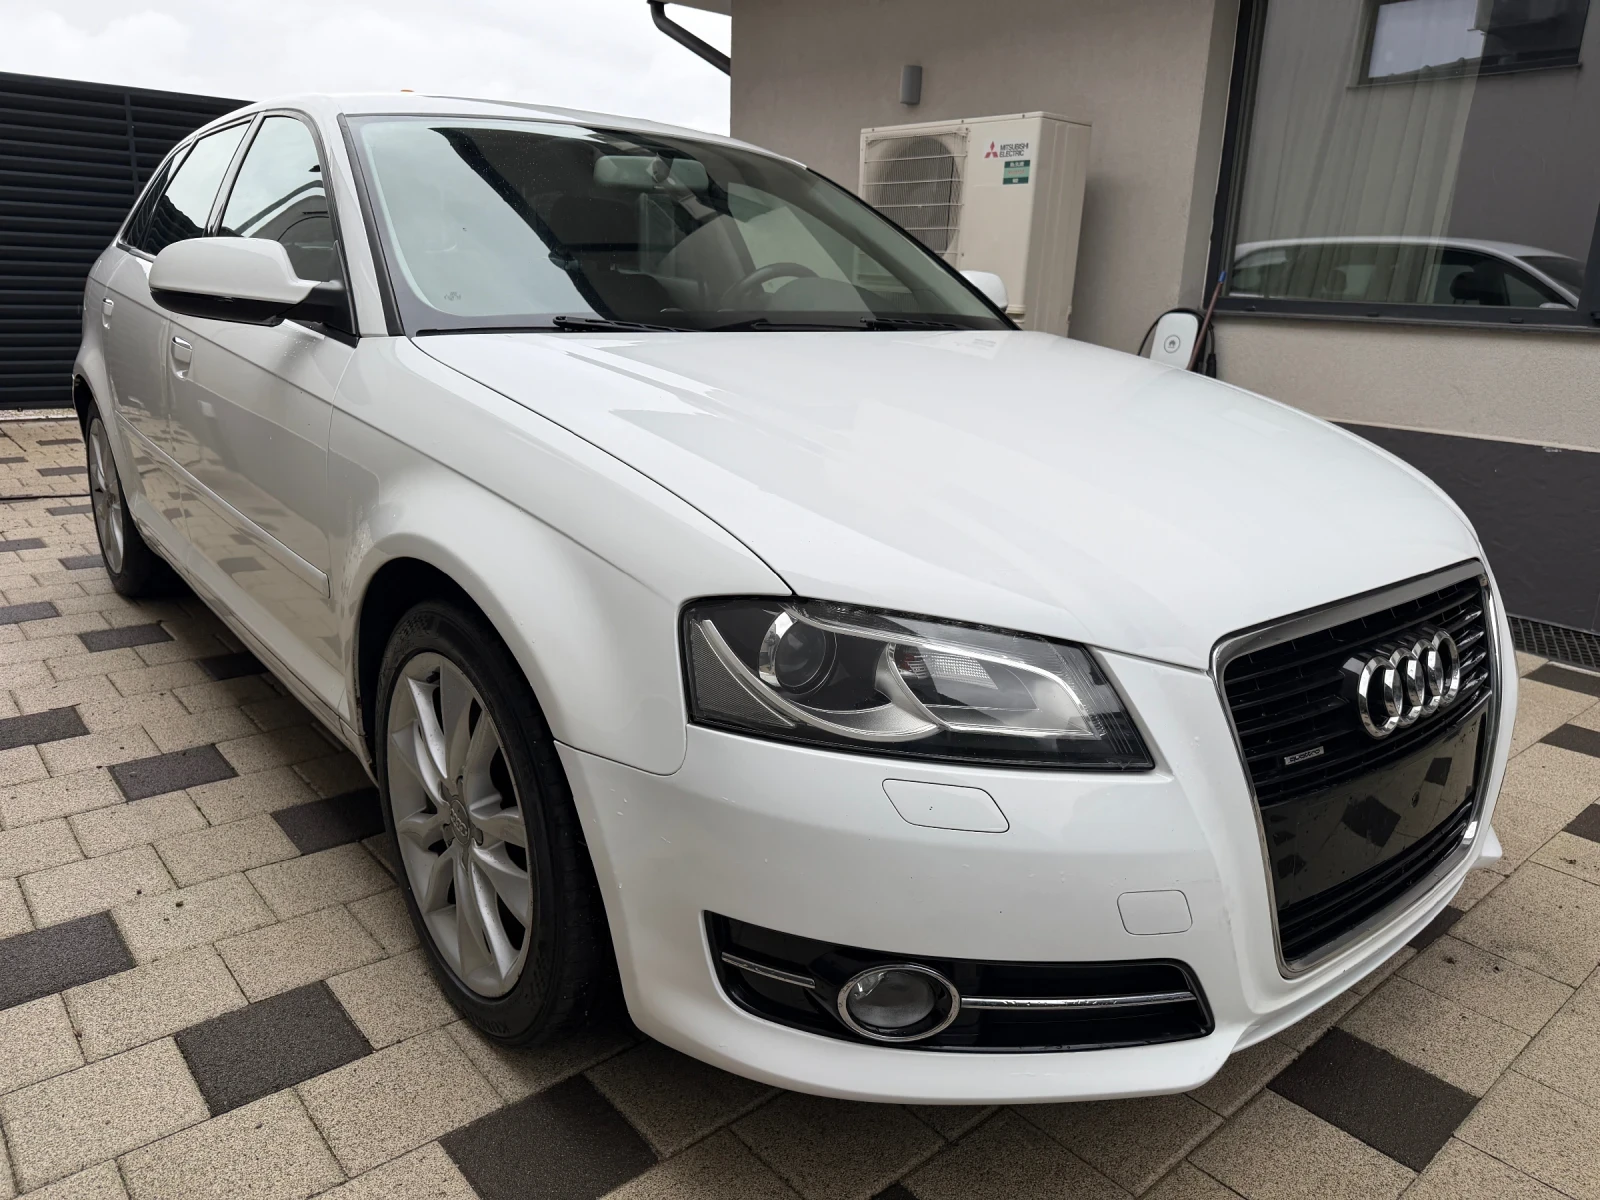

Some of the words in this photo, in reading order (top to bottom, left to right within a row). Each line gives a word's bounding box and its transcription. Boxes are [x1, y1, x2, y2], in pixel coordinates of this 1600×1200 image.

[1000, 143, 1029, 151] MITSUBISHI
[999, 150, 1025, 158] ELECTRIC
[1288, 749, 1321, 763] quattro
